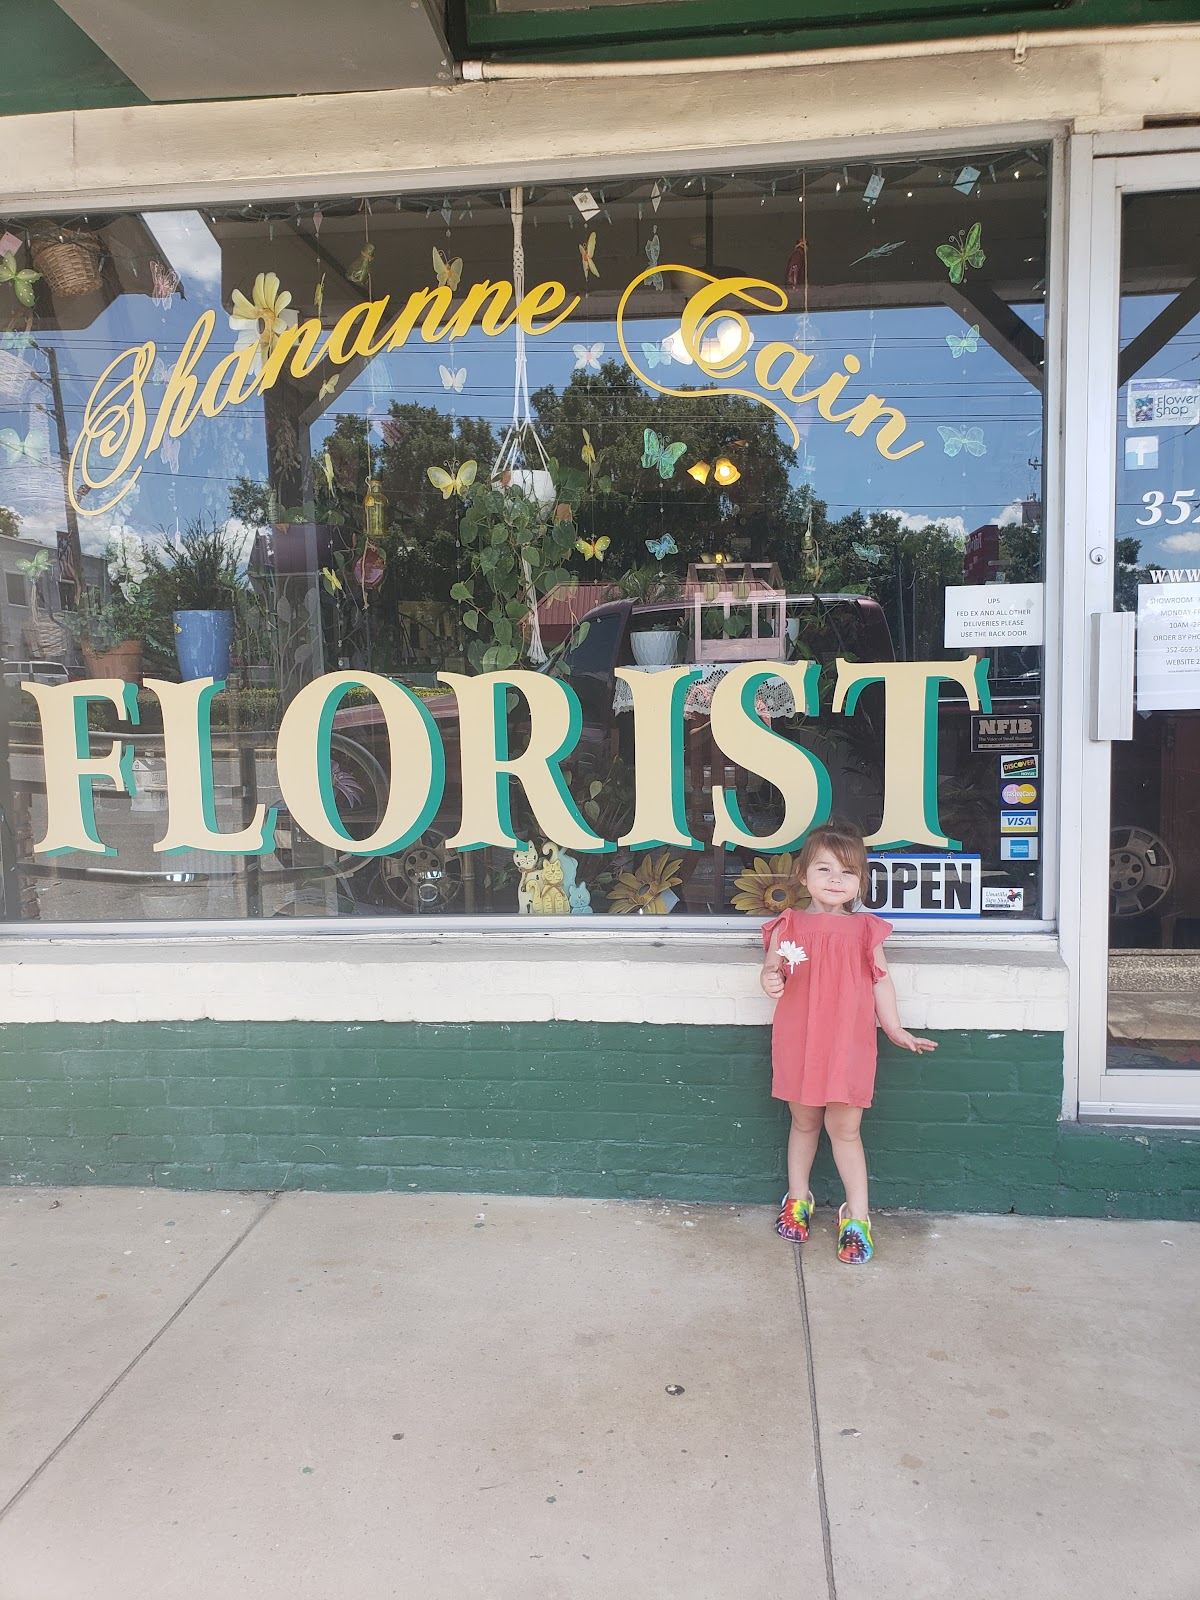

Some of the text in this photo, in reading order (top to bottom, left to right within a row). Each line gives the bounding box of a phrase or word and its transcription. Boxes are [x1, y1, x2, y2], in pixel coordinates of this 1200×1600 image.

[68, 263, 926, 517] Shananne Cain
[1157, 394, 1199, 408] Flower
[1150, 597, 1193, 605] SHOWROOM
[1165, 658, 1194, 666] WEBSITE
[979, 718, 1033, 735] NFIB
[21, 655, 992, 857] FLORIST
[1003, 760, 1035, 771] DISCOVER
[1007, 817, 1032, 826] VISA
[861, 861, 972, 910] OPEN
